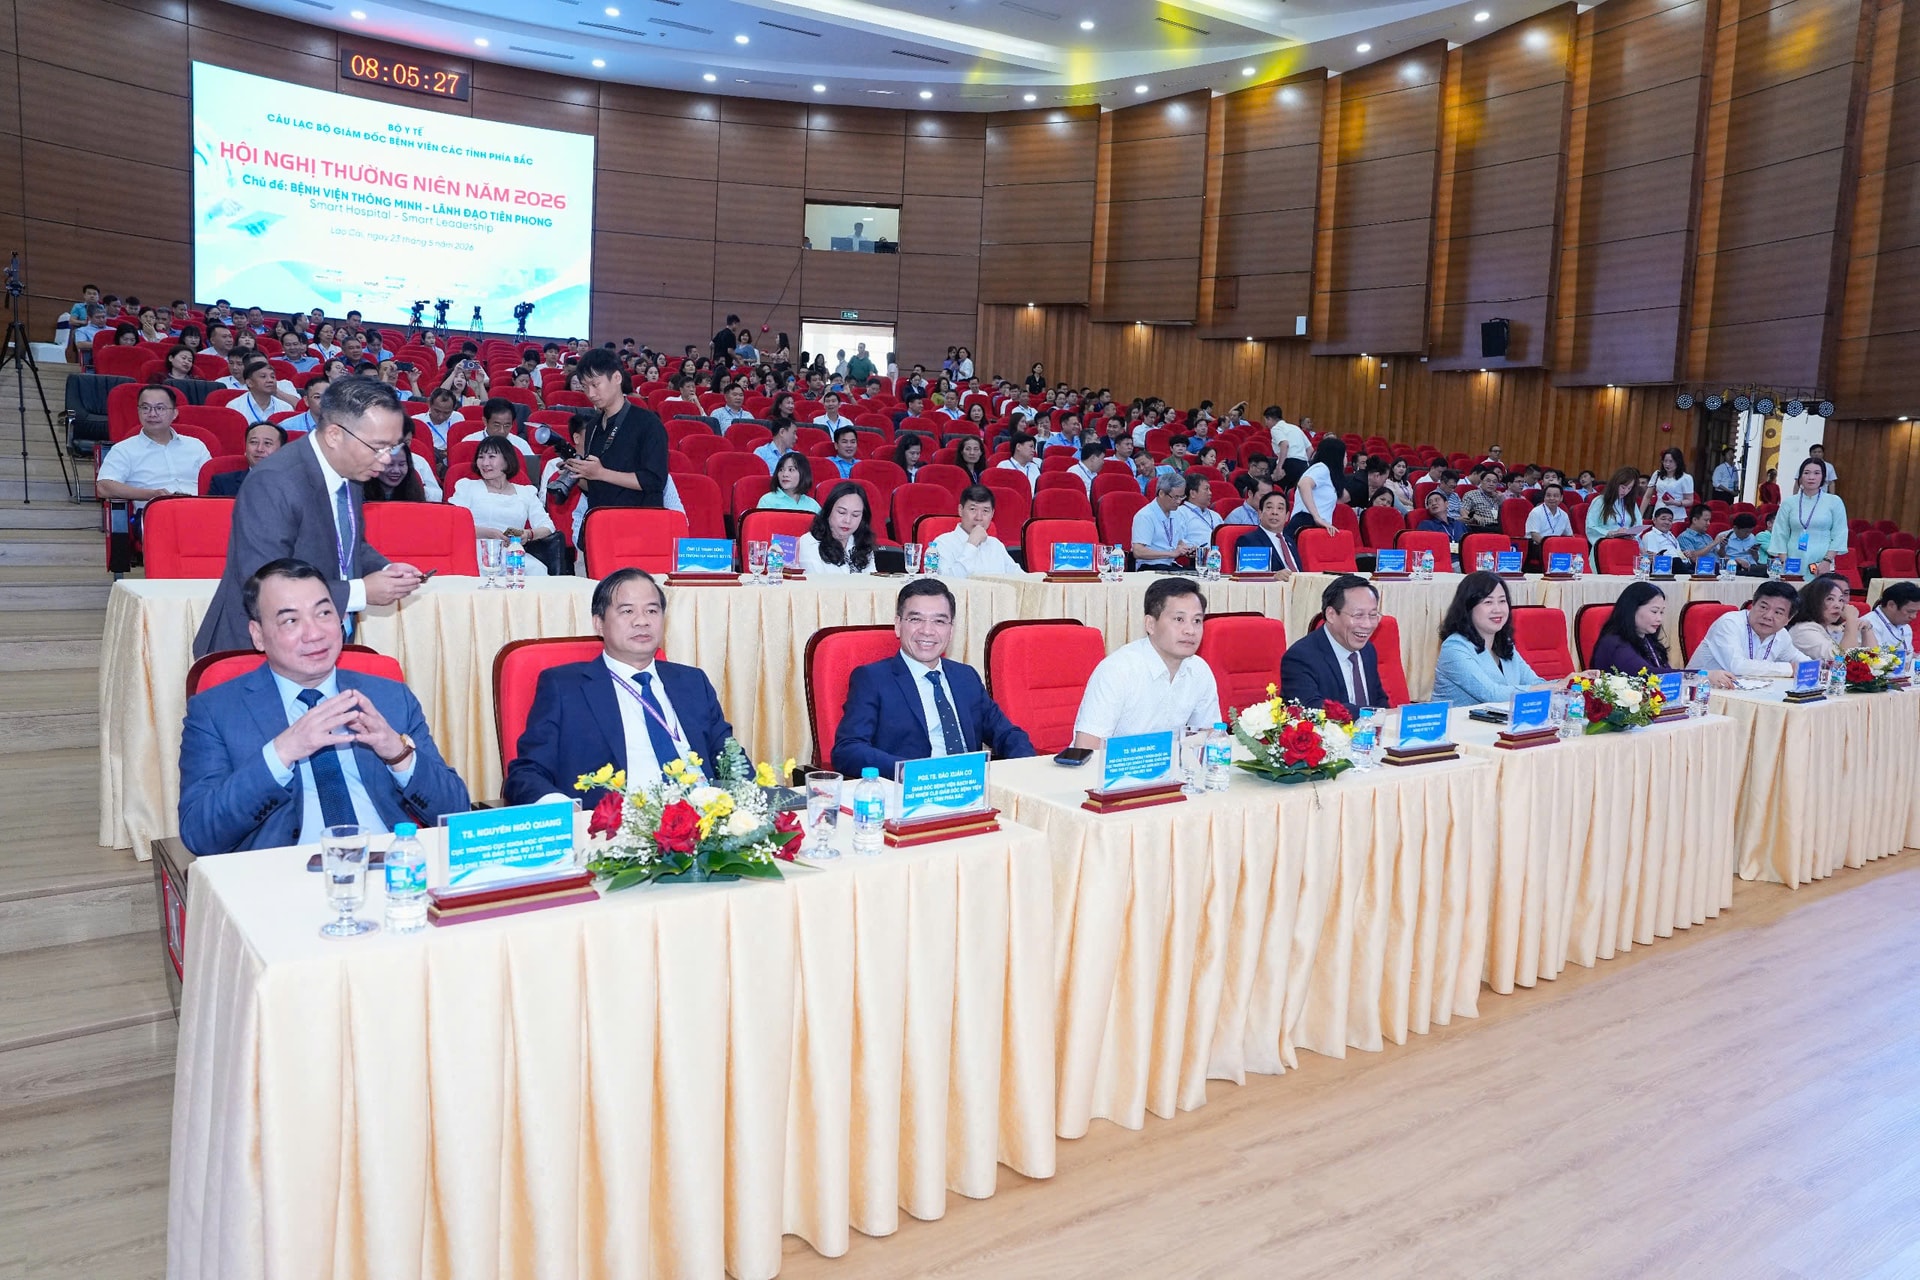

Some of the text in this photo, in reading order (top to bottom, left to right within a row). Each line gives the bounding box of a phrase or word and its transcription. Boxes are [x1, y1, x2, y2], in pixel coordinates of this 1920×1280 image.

[351, 55, 459, 94] 08:05:27
[267, 113, 290, 125] CÂU
[333, 126, 361, 138] GIÁM
[363, 131, 386, 143] ĐỐC
[441, 145, 463, 156] CÁC
[489, 152, 511, 163] PHÍA
[514, 153, 533, 165] BẮC
[220, 141, 566, 210] HỘI NGHỊ THƯỜNG NIÊN NĂM 2026
[242, 174, 266, 188] Chủ
[290, 182, 320, 197] BỆNH
[323, 187, 349, 202] VIỆN
[351, 192, 391, 207] THÔNG
[394, 199, 422, 211] MINH
[433, 203, 461, 217] LÃNH
[463, 208, 488, 222] ĐẠO
[490, 210, 512, 223] TIÊN
[514, 216, 553, 228] PHONG
[309, 199, 342, 213] Smart
[346, 204, 391, 220] Hospital
[402, 210, 433, 226] Smart
[436, 214, 494, 233] Leadership
[533, 818, 562, 830] QUANG
